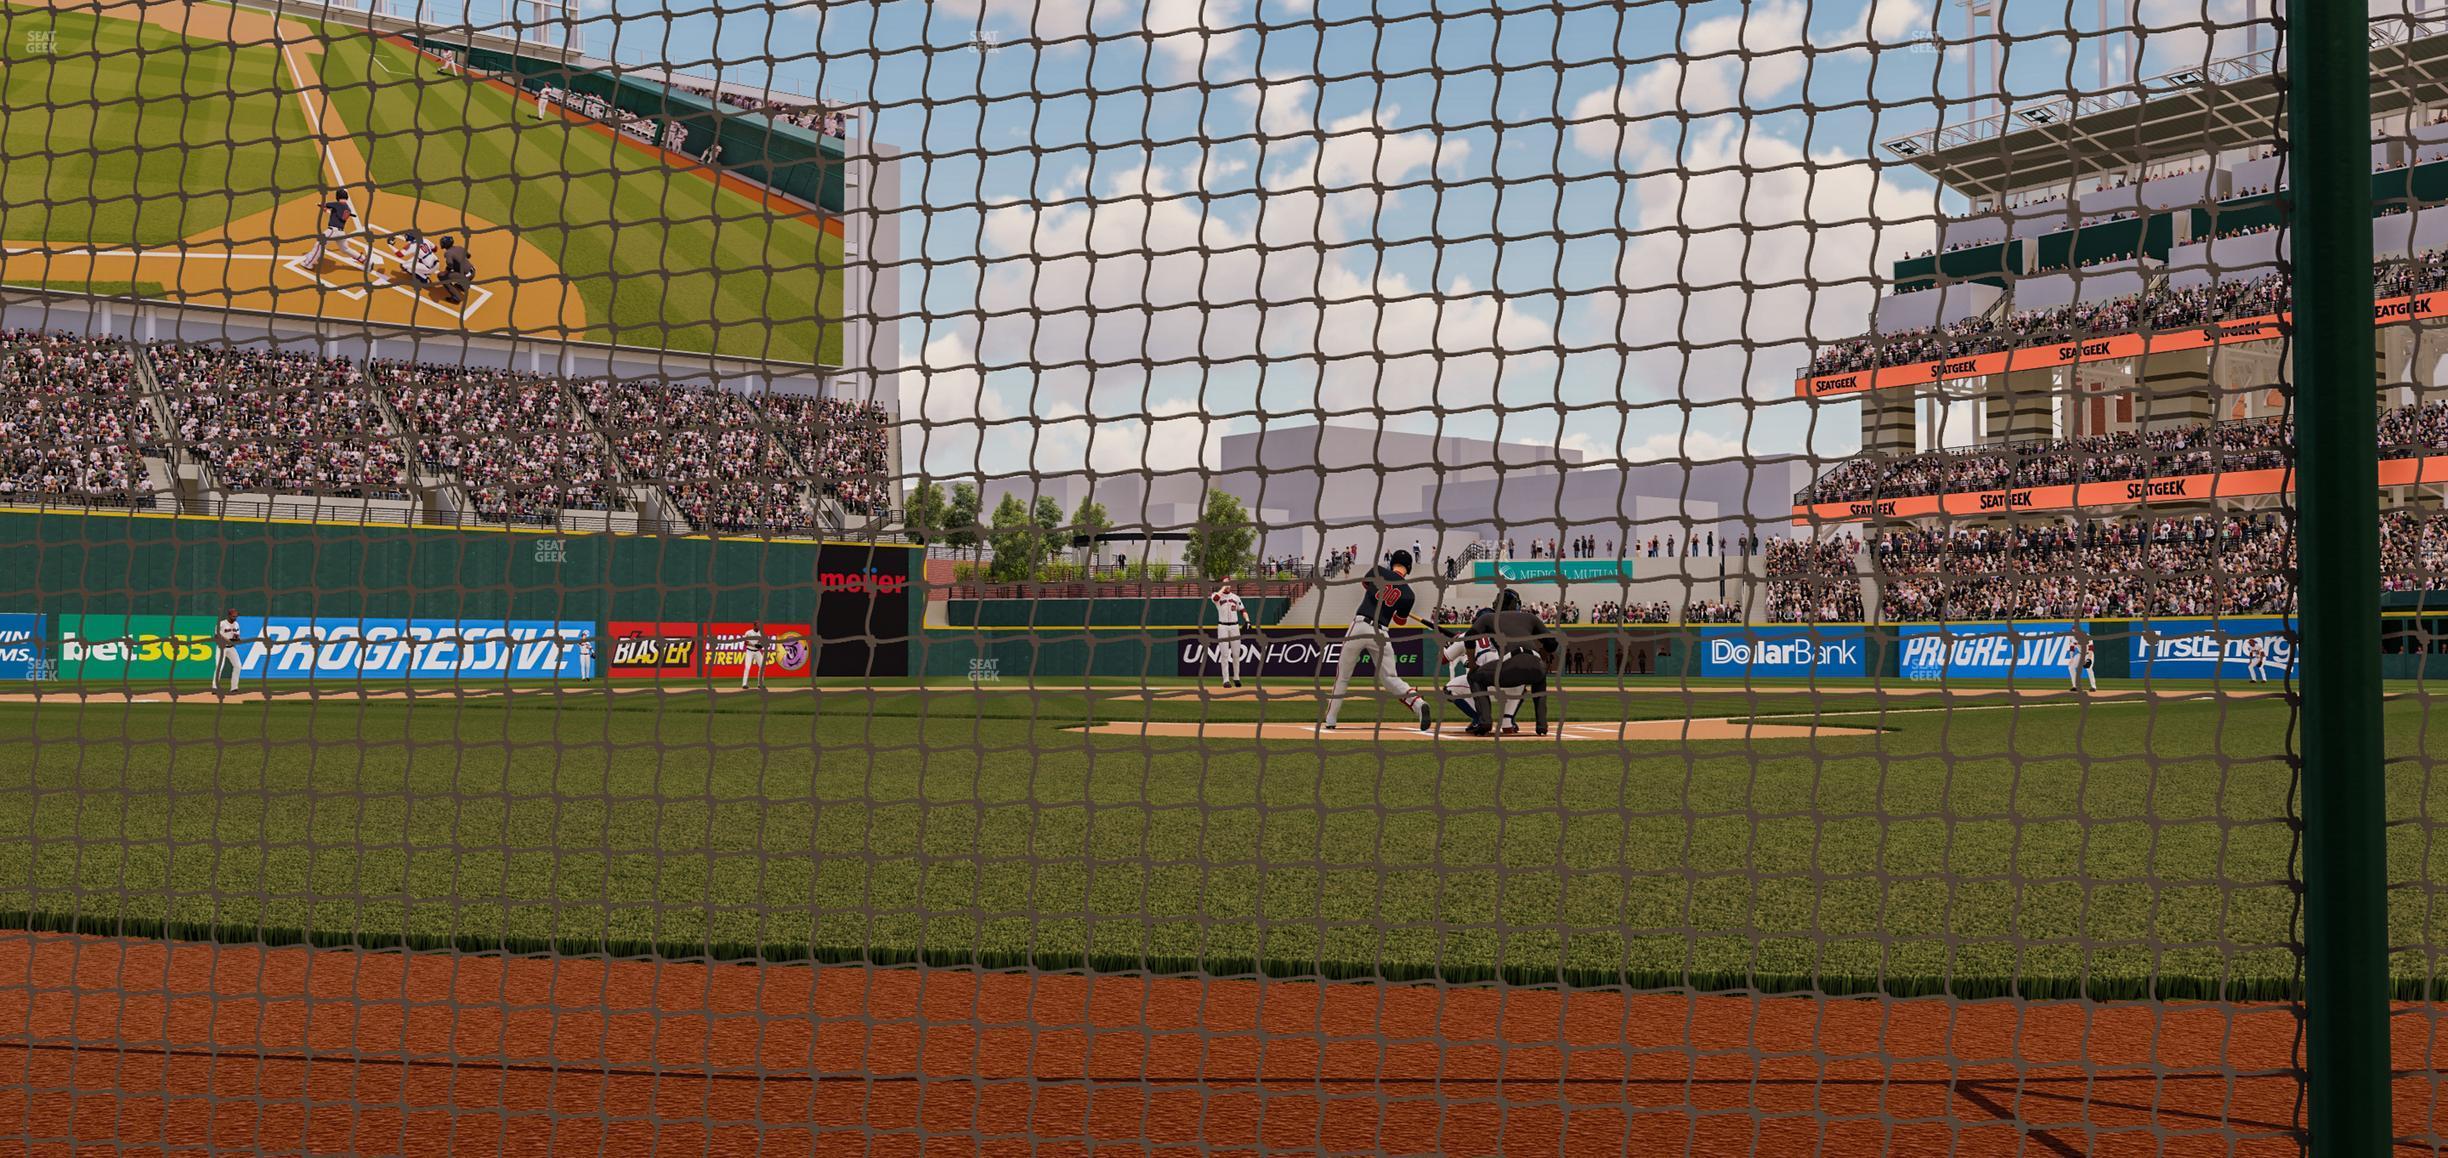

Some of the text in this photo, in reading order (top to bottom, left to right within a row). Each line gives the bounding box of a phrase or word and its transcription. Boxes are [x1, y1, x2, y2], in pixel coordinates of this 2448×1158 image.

[2375, 298, 2432, 318] EATGEEK
[2204, 321, 2261, 341] STGEEK
[1816, 376, 1857, 392] SEATGEEK
[2127, 479, 2186, 499] SETGEEK
[1850, 501, 1896, 515] SEATEEK
[1980, 490, 2032, 509] SEATEEK
[1520, 569, 1571, 580] MEDICL
[63, 632, 212, 661] bet365
[240, 626, 582, 670] PROGRESSIVE
[1712, 639, 1857, 664] DollarBank
[2138, 629, 2299, 663] FirstEnerg
